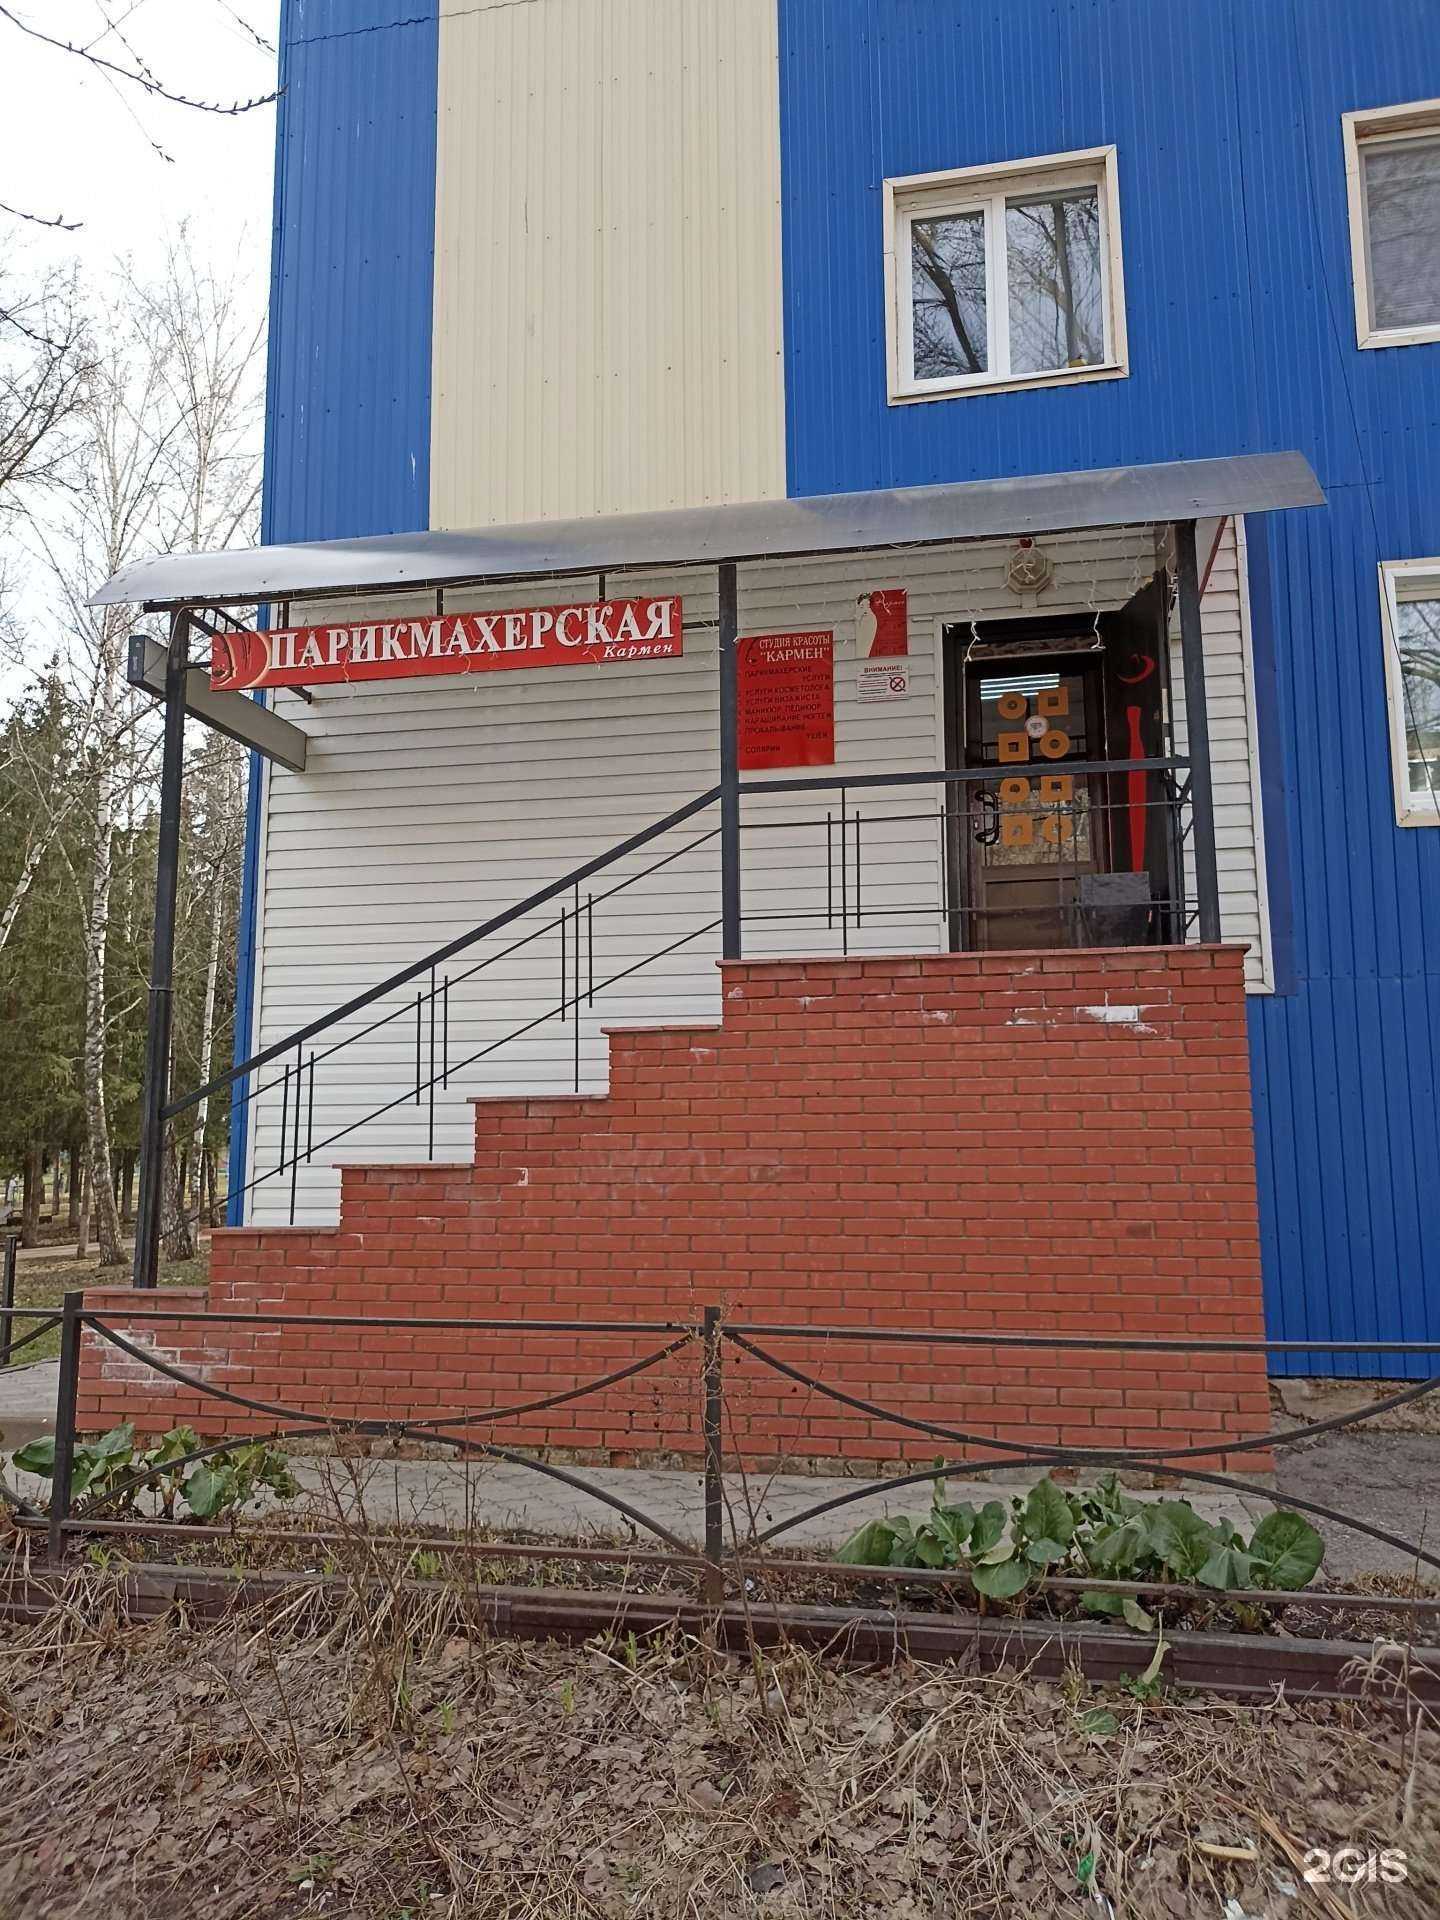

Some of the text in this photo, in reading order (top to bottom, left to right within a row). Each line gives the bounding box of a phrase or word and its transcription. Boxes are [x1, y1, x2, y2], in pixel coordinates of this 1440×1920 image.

[269, 600, 675, 668] ПАРИКМАХЕРСКАЯ
[759, 635, 830, 650] СТУДИЯ КРАСОТЫ
[604, 643, 674, 659] Кармен
[760, 647, 830, 662] "КАРМЕН"
